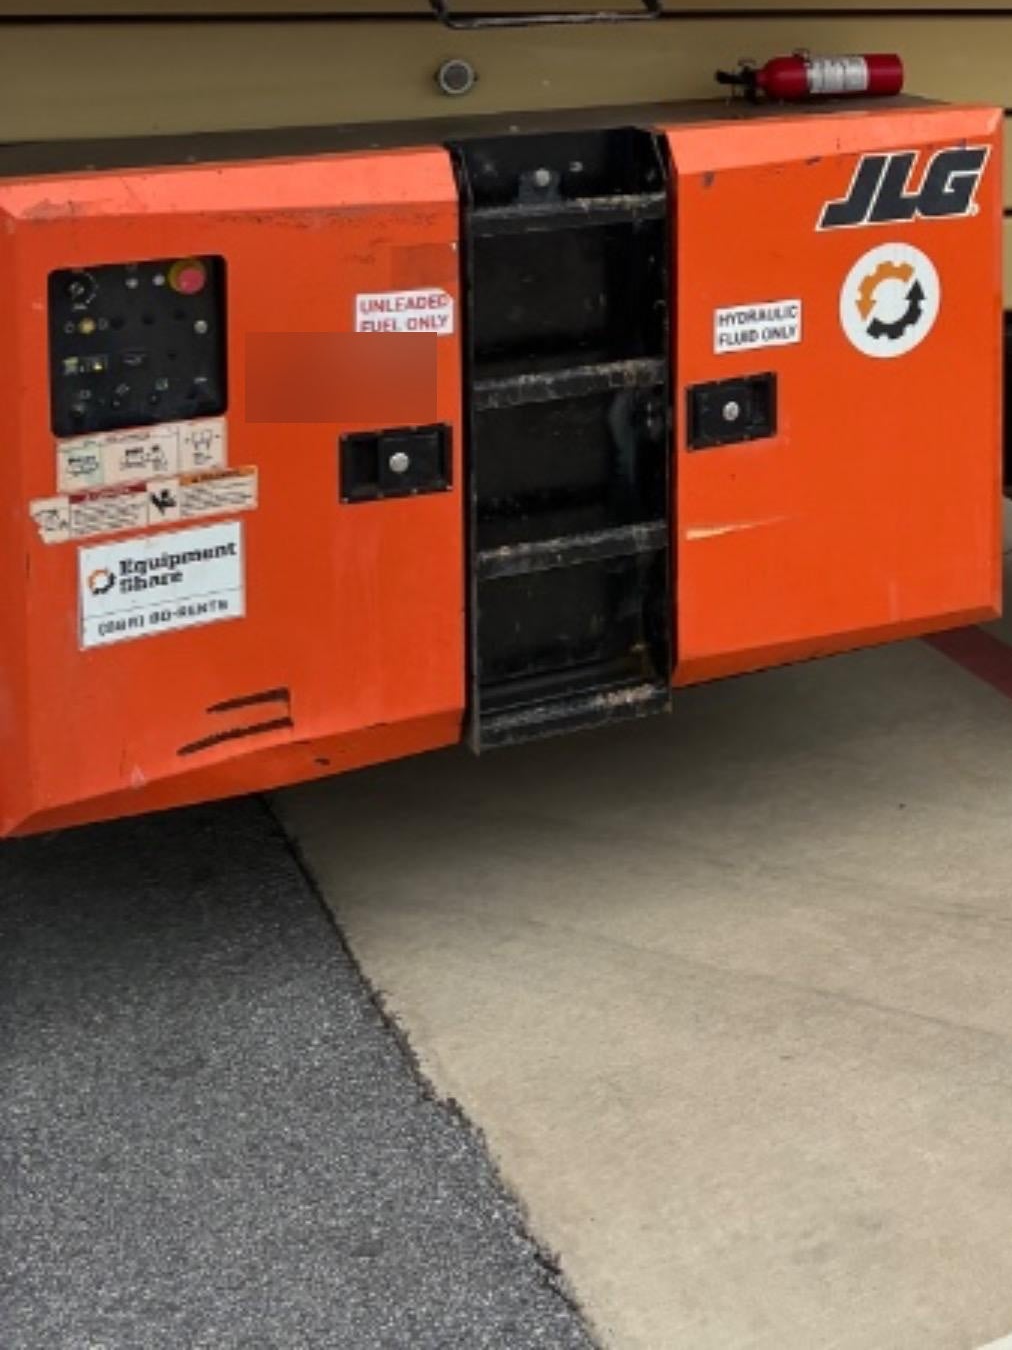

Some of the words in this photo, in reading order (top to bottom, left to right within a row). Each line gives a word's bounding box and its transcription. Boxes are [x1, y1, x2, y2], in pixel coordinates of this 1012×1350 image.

[815, 145, 992, 232] JLG
[360, 317, 403, 333] FUEL
[406, 313, 449, 331] ONLY
[719, 304, 798, 327] HYDRAULIC
[719, 329, 760, 348] FLUID
[760, 324, 797, 342] ONLY
[119, 541, 237, 576] Equipment
[119, 570, 184, 594] Share
